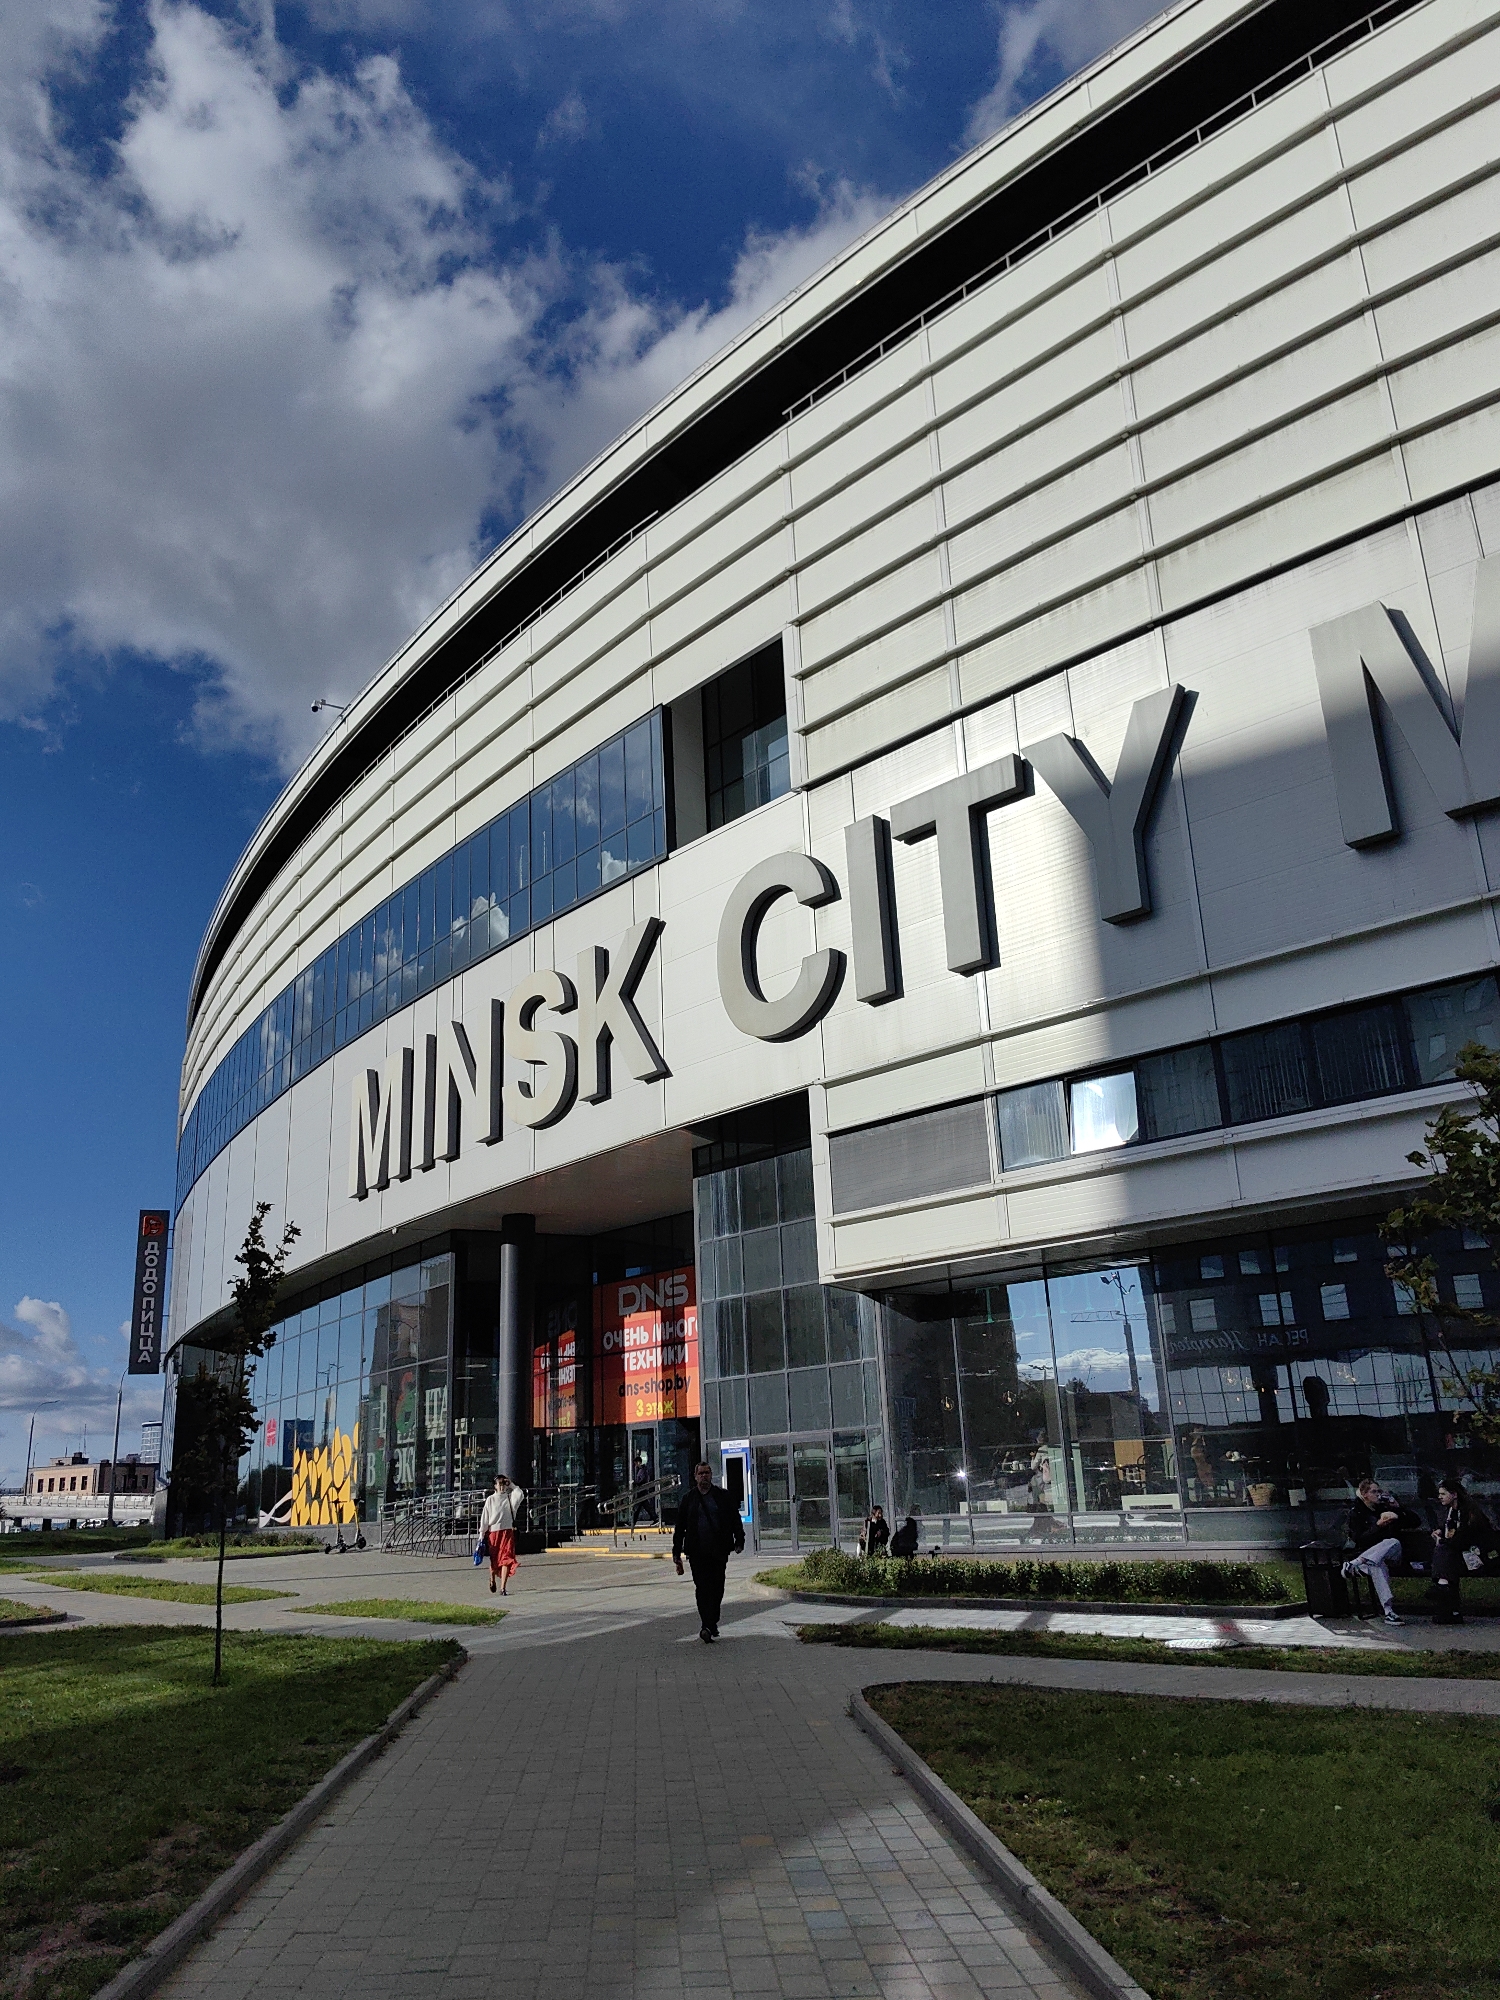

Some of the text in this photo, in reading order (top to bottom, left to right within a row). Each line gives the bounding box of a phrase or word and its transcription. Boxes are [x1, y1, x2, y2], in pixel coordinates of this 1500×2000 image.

[349, 916, 672, 1201] MINSK
[717, 683, 1196, 1043] CITY
[618, 1273, 689, 1316] DNS
[603, 1325, 649, 1350] ОЧЕНЬ
[622, 1343, 689, 1372] ТЕХНИКИ
[618, 1374, 691, 1397] dns-shop.by
[635, 1398, 675, 1417] 3 ЭТАЖ
